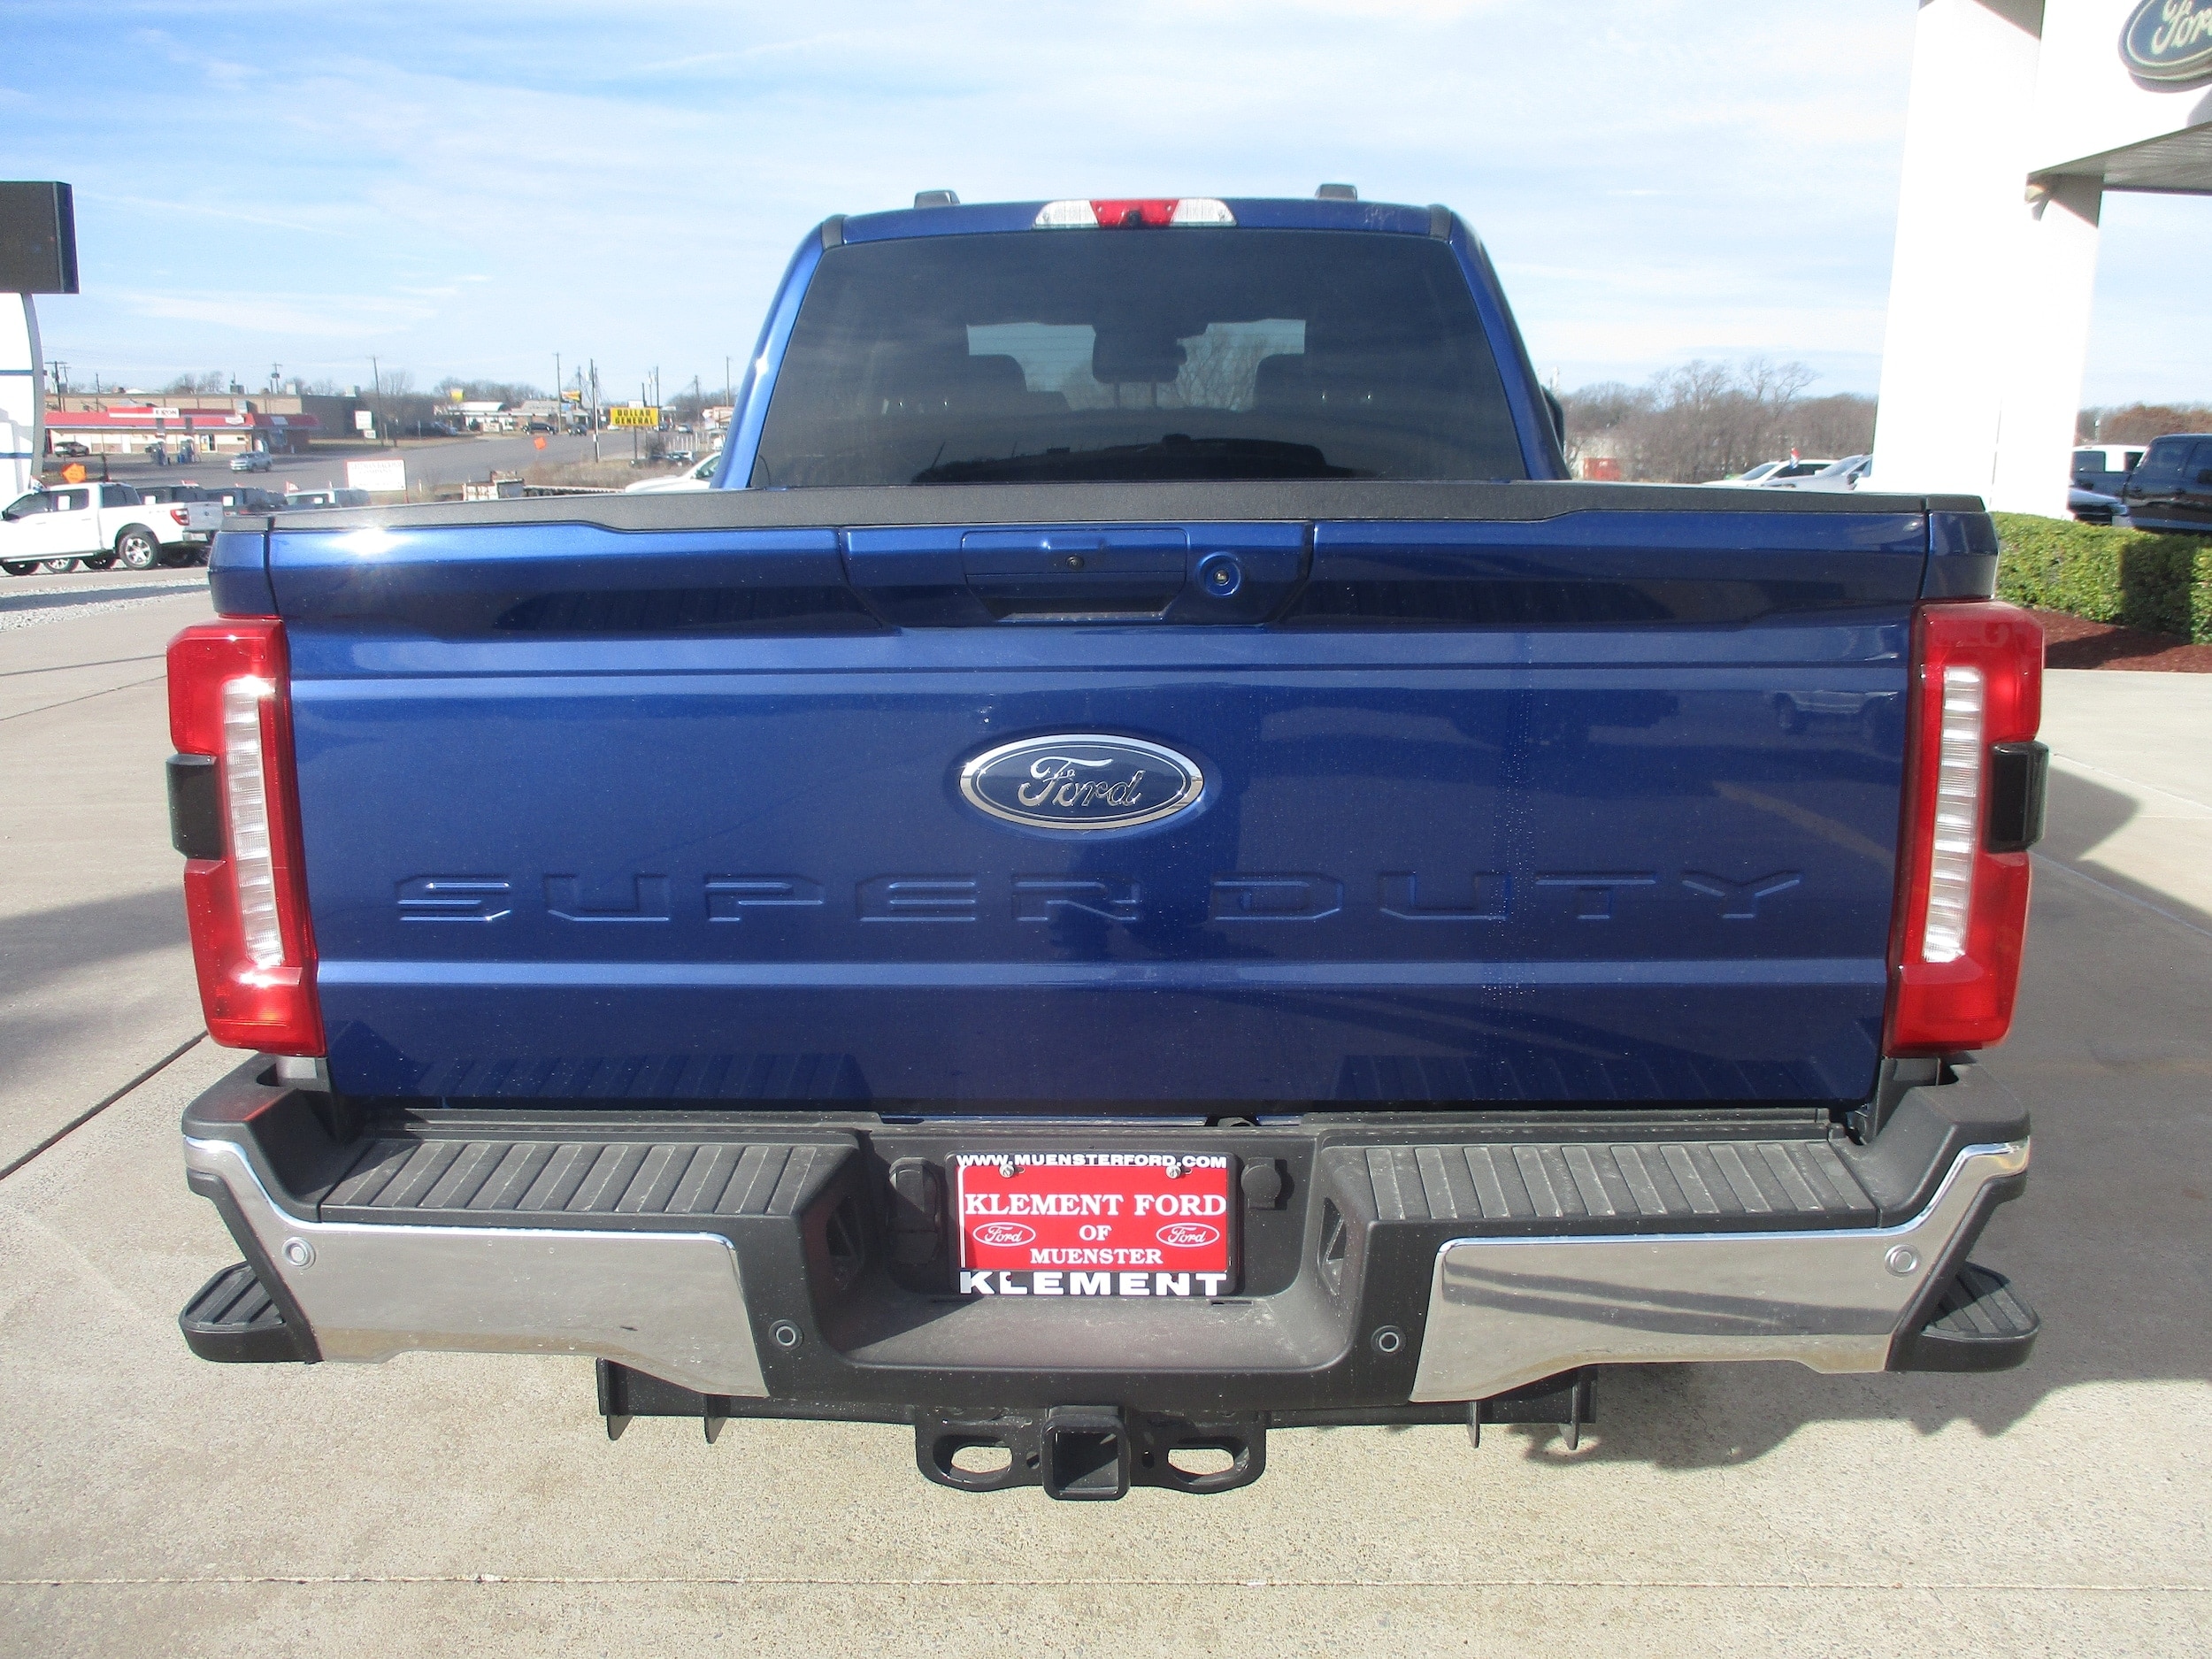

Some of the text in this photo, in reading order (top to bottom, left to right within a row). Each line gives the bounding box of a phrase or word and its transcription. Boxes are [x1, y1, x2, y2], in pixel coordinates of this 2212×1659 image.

[2151, 0, 2212, 55] For
[1018, 756, 1147, 807] Ford
[396, 871, 1802, 923] SUPER DUTY
[956, 1154, 1227, 1168] WWW.MUENSTERFORD.COM
[964, 1194, 1228, 1217] KLEMENT FORD
[984, 1225, 1023, 1243] Ford
[1079, 1225, 1113, 1241] OF
[1167, 1225, 1207, 1244] Ford
[1029, 1248, 1164, 1265] MUENSTER
[959, 1271, 1228, 1296] KLEMENT
